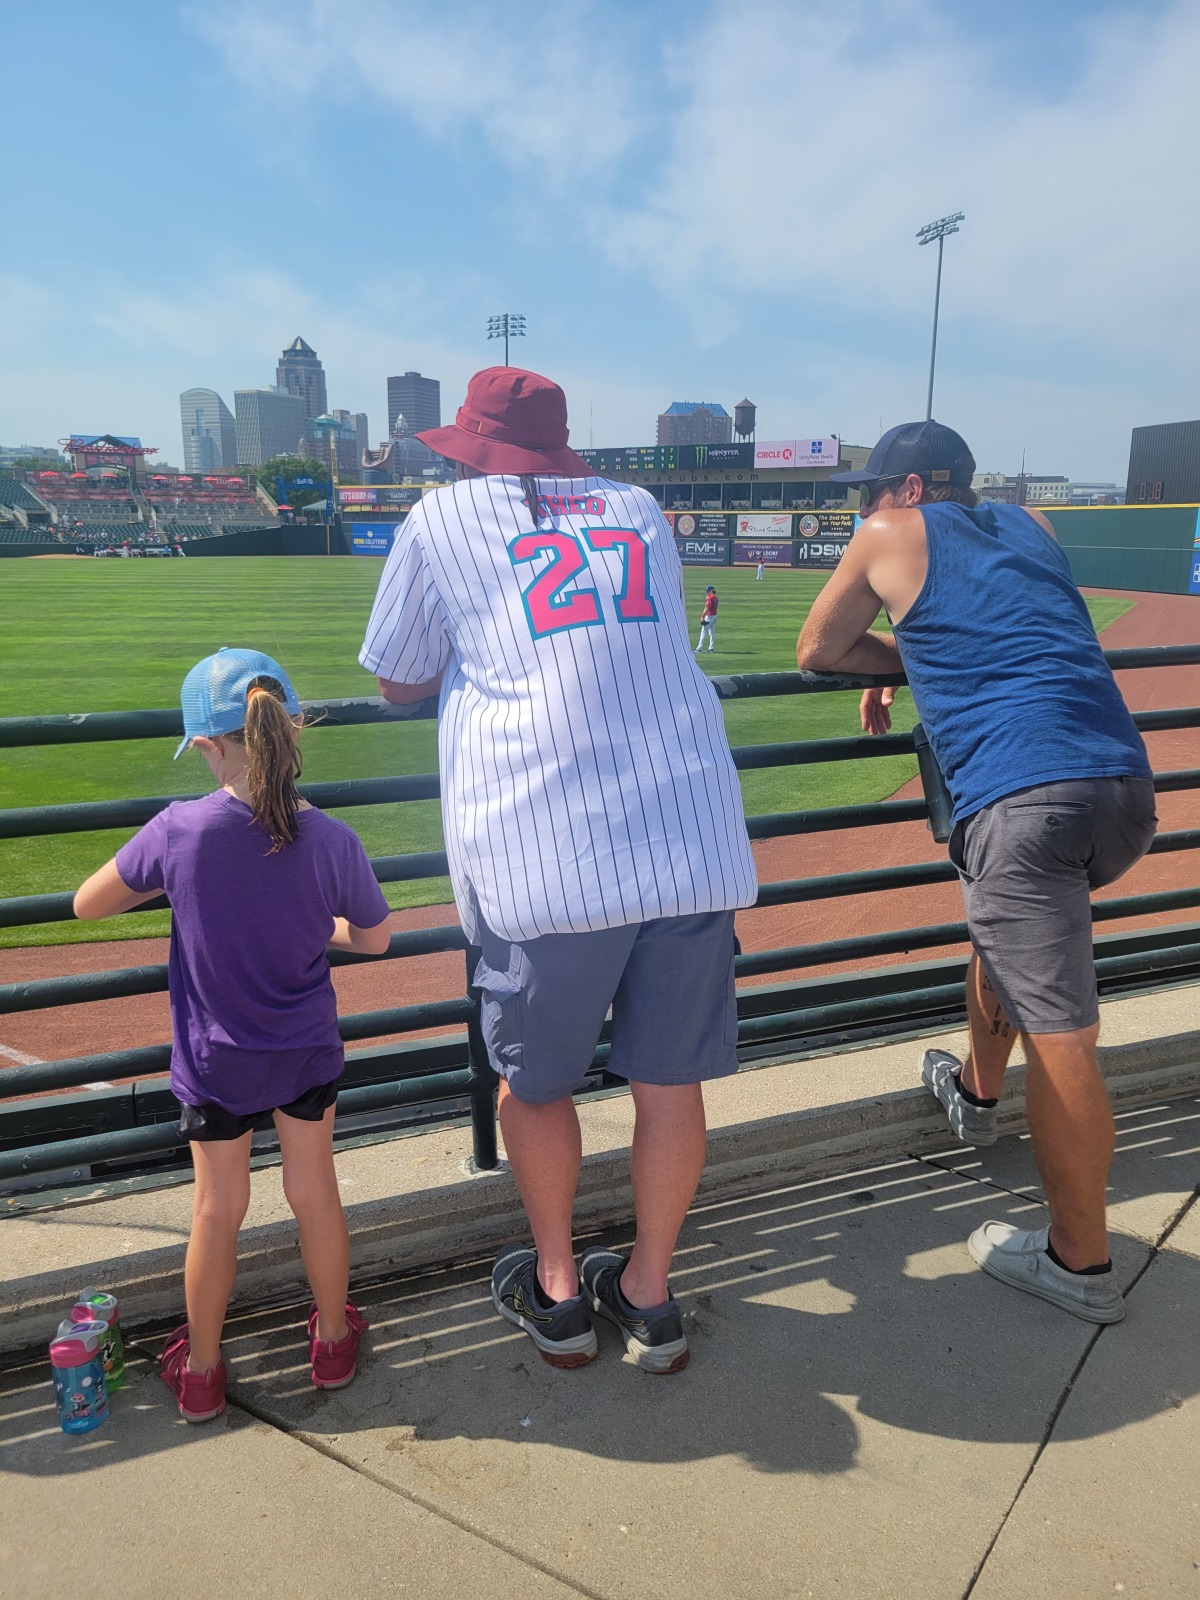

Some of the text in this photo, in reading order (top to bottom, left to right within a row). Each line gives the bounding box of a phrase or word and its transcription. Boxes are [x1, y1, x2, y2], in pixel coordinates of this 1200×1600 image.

[57, 438, 160, 455] Budweiser
[708, 449, 740, 457] MONSTER
[756, 450, 781, 459] CIRCLE
[686, 542, 716, 553] FMH
[810, 544, 848, 556] DSM
[507, 526, 660, 641] 27
